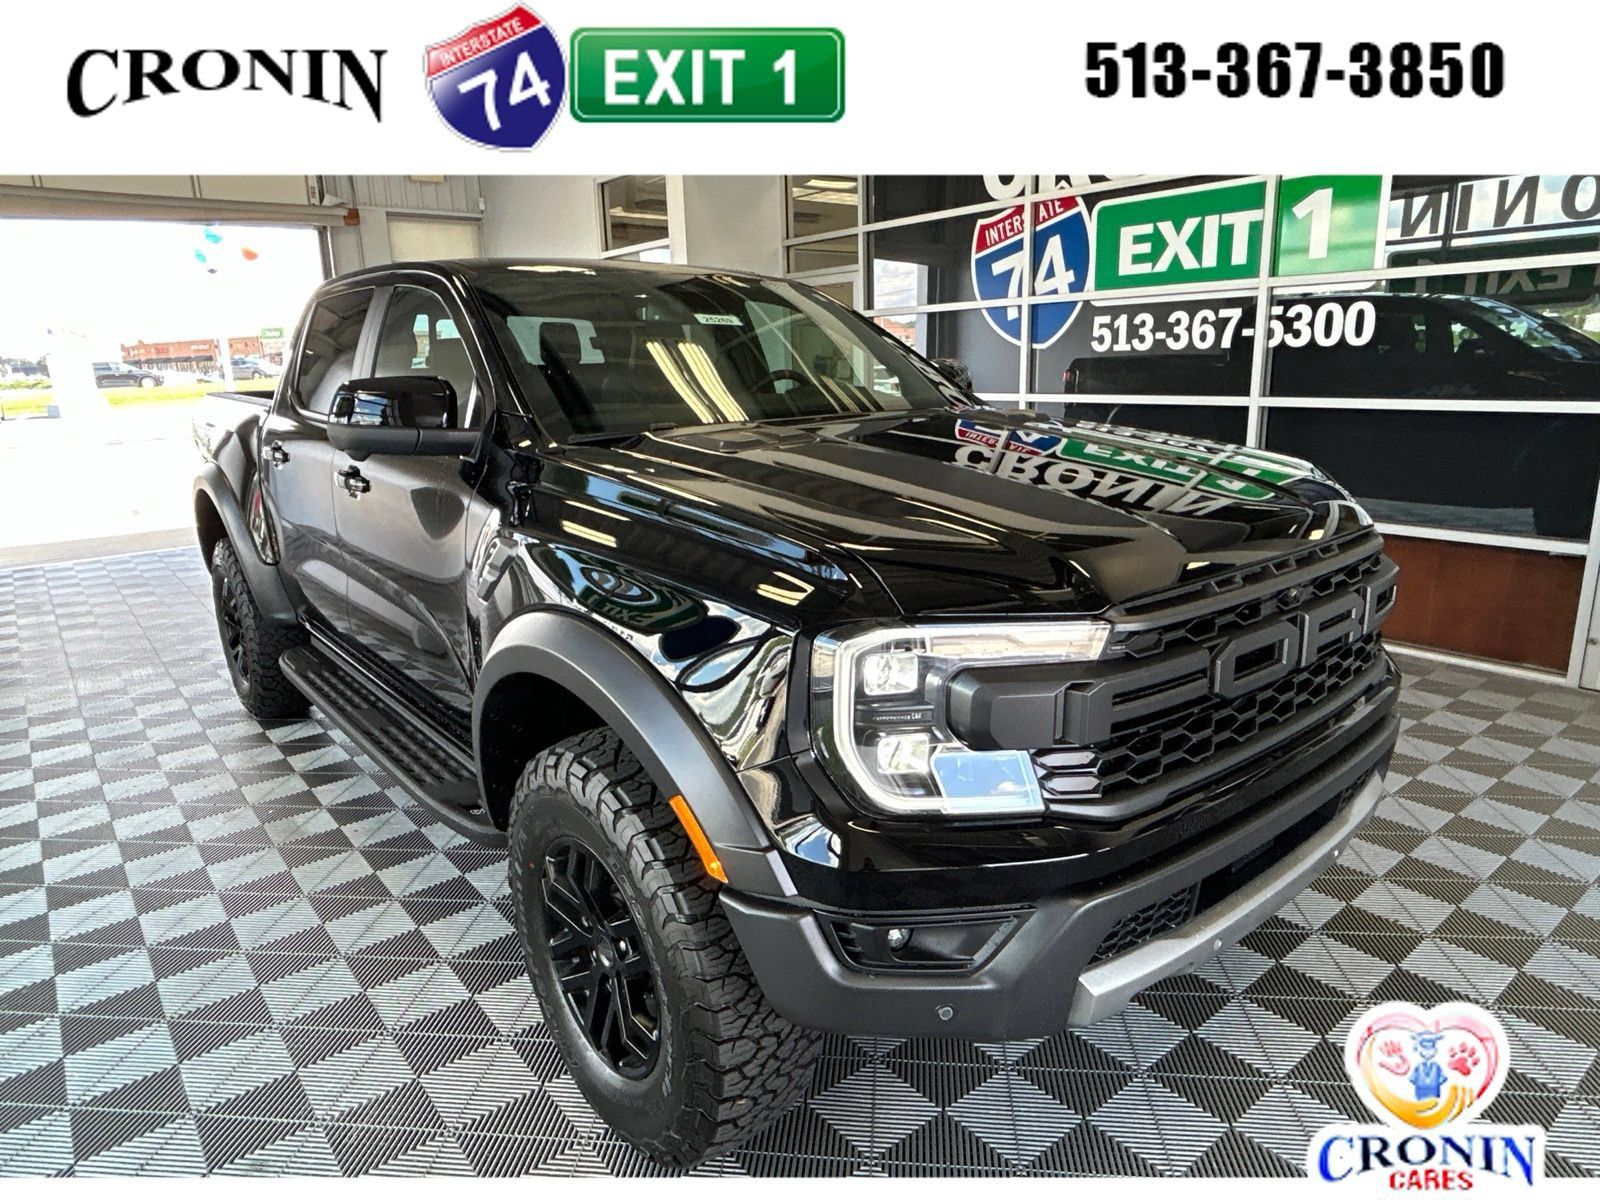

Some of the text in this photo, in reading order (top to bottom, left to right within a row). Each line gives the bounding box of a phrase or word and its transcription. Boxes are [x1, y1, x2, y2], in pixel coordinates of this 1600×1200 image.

[1118, 188, 1334, 276] EXIT 1
[991, 234, 1075, 321] 74
[1091, 302, 1376, 352] 513-367-5300
[1086, 584, 1398, 747] FORD
